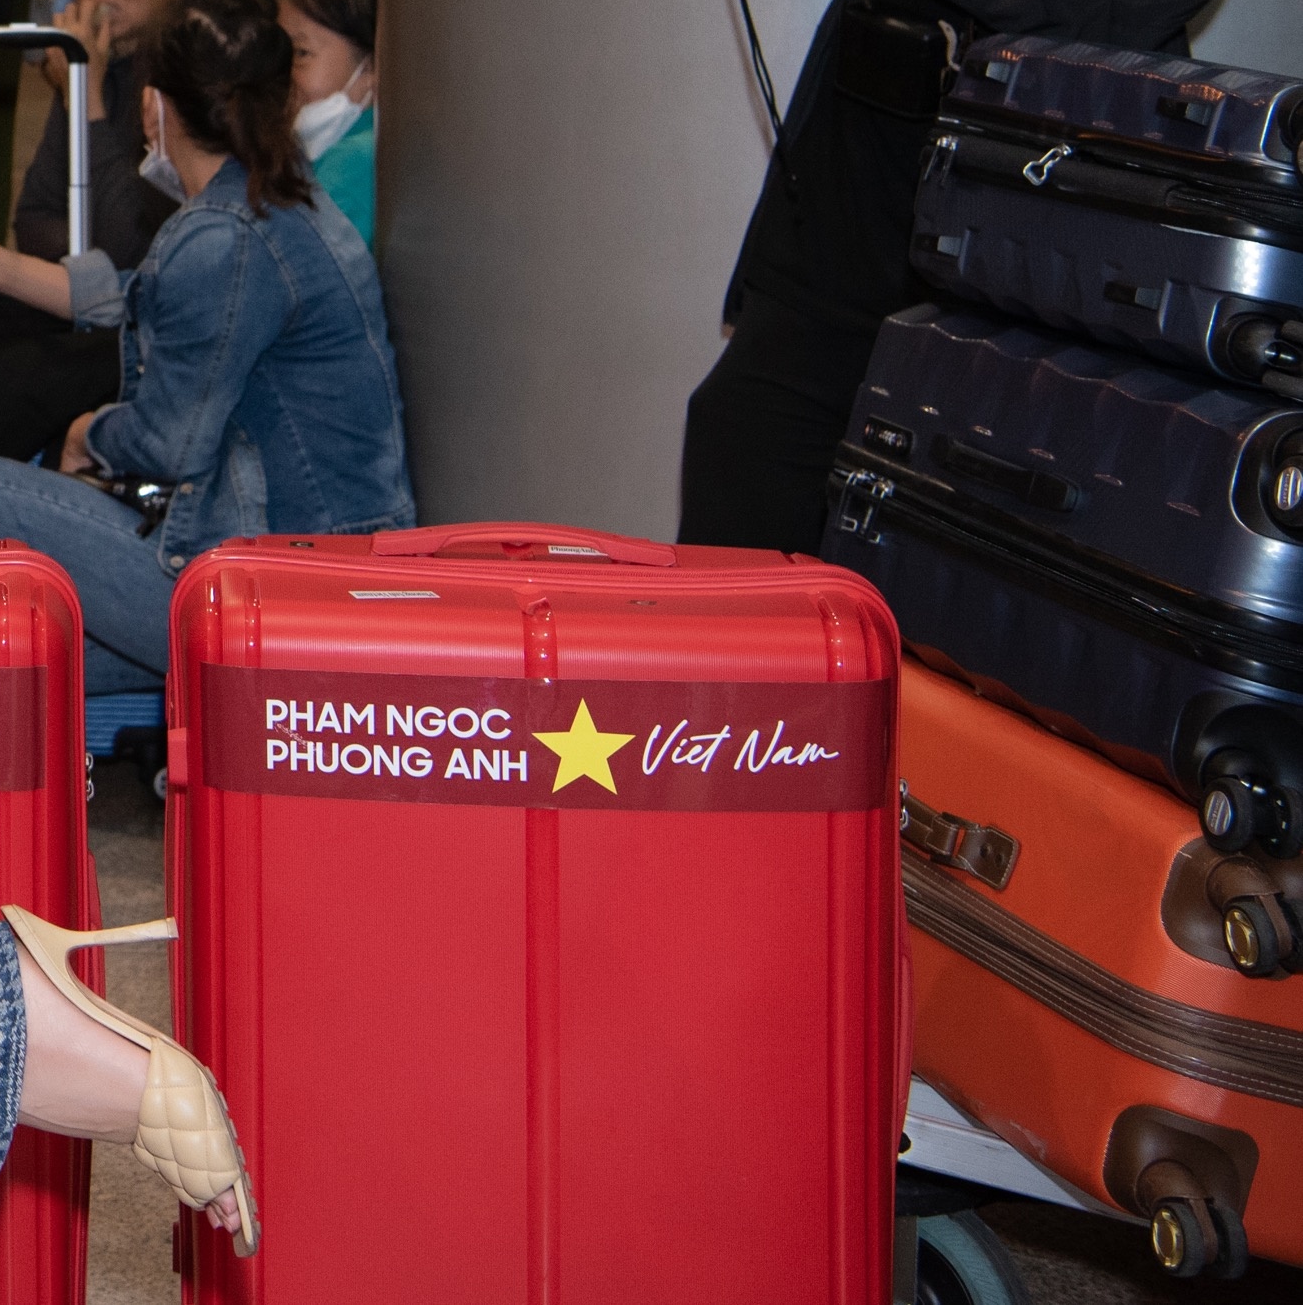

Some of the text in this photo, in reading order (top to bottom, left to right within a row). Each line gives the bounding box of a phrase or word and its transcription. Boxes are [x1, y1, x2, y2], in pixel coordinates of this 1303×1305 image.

[265, 698, 512, 740] PHAM NGOC
[265, 739, 528, 783] PHUONG ANH
[641, 719, 839, 775] Viet Nam
